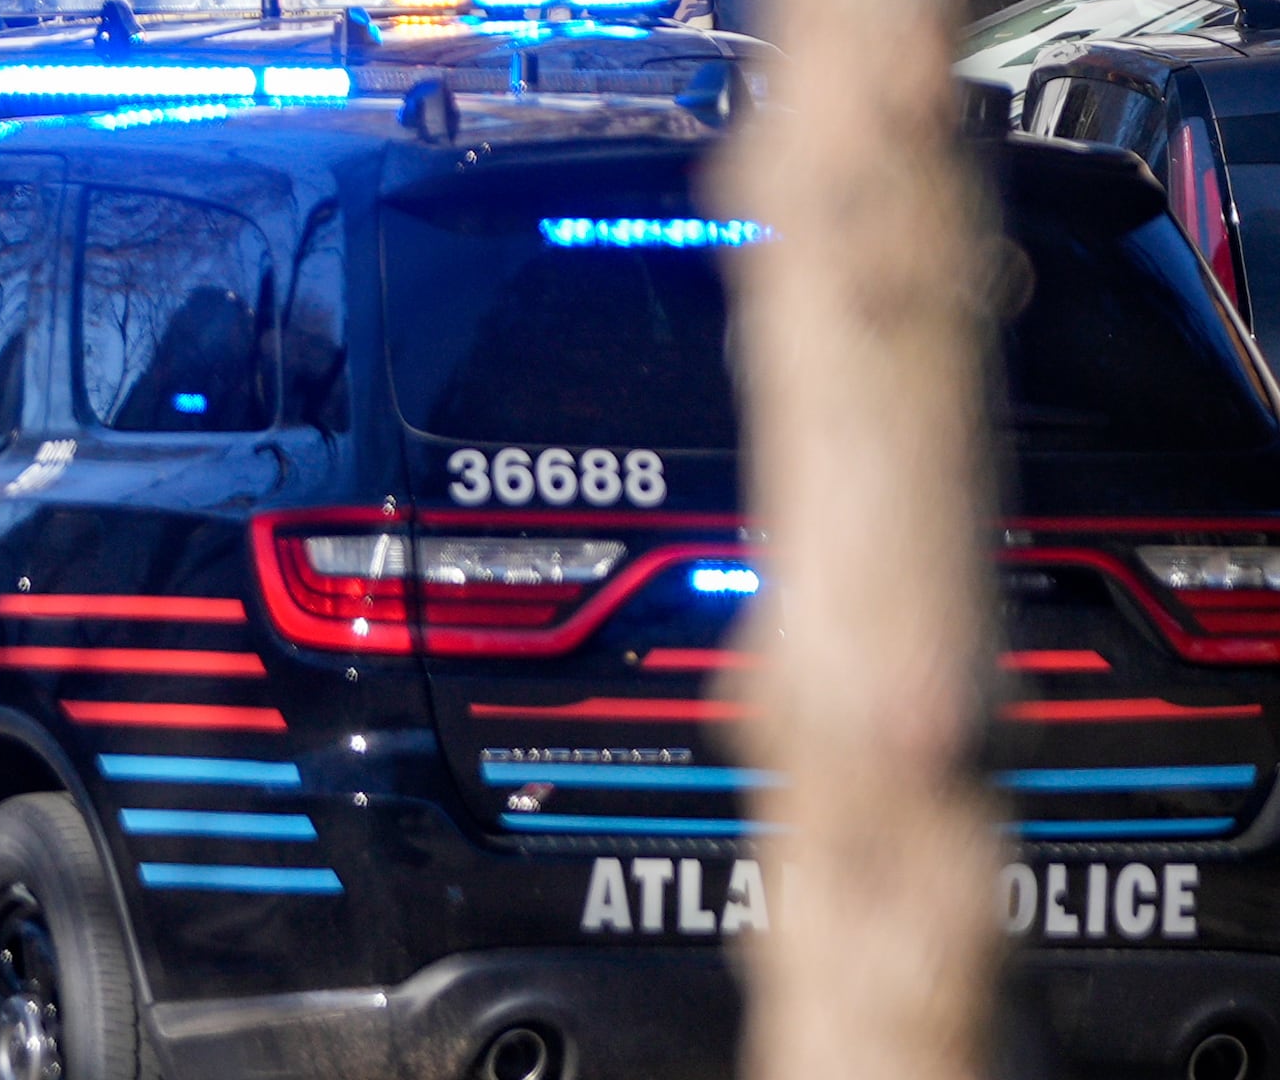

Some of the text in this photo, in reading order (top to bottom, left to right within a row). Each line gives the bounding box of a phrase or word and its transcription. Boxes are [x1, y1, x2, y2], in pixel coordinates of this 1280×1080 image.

[446, 446, 668, 508] 36688
[579, 855, 1201, 939] ATLA OLICE
